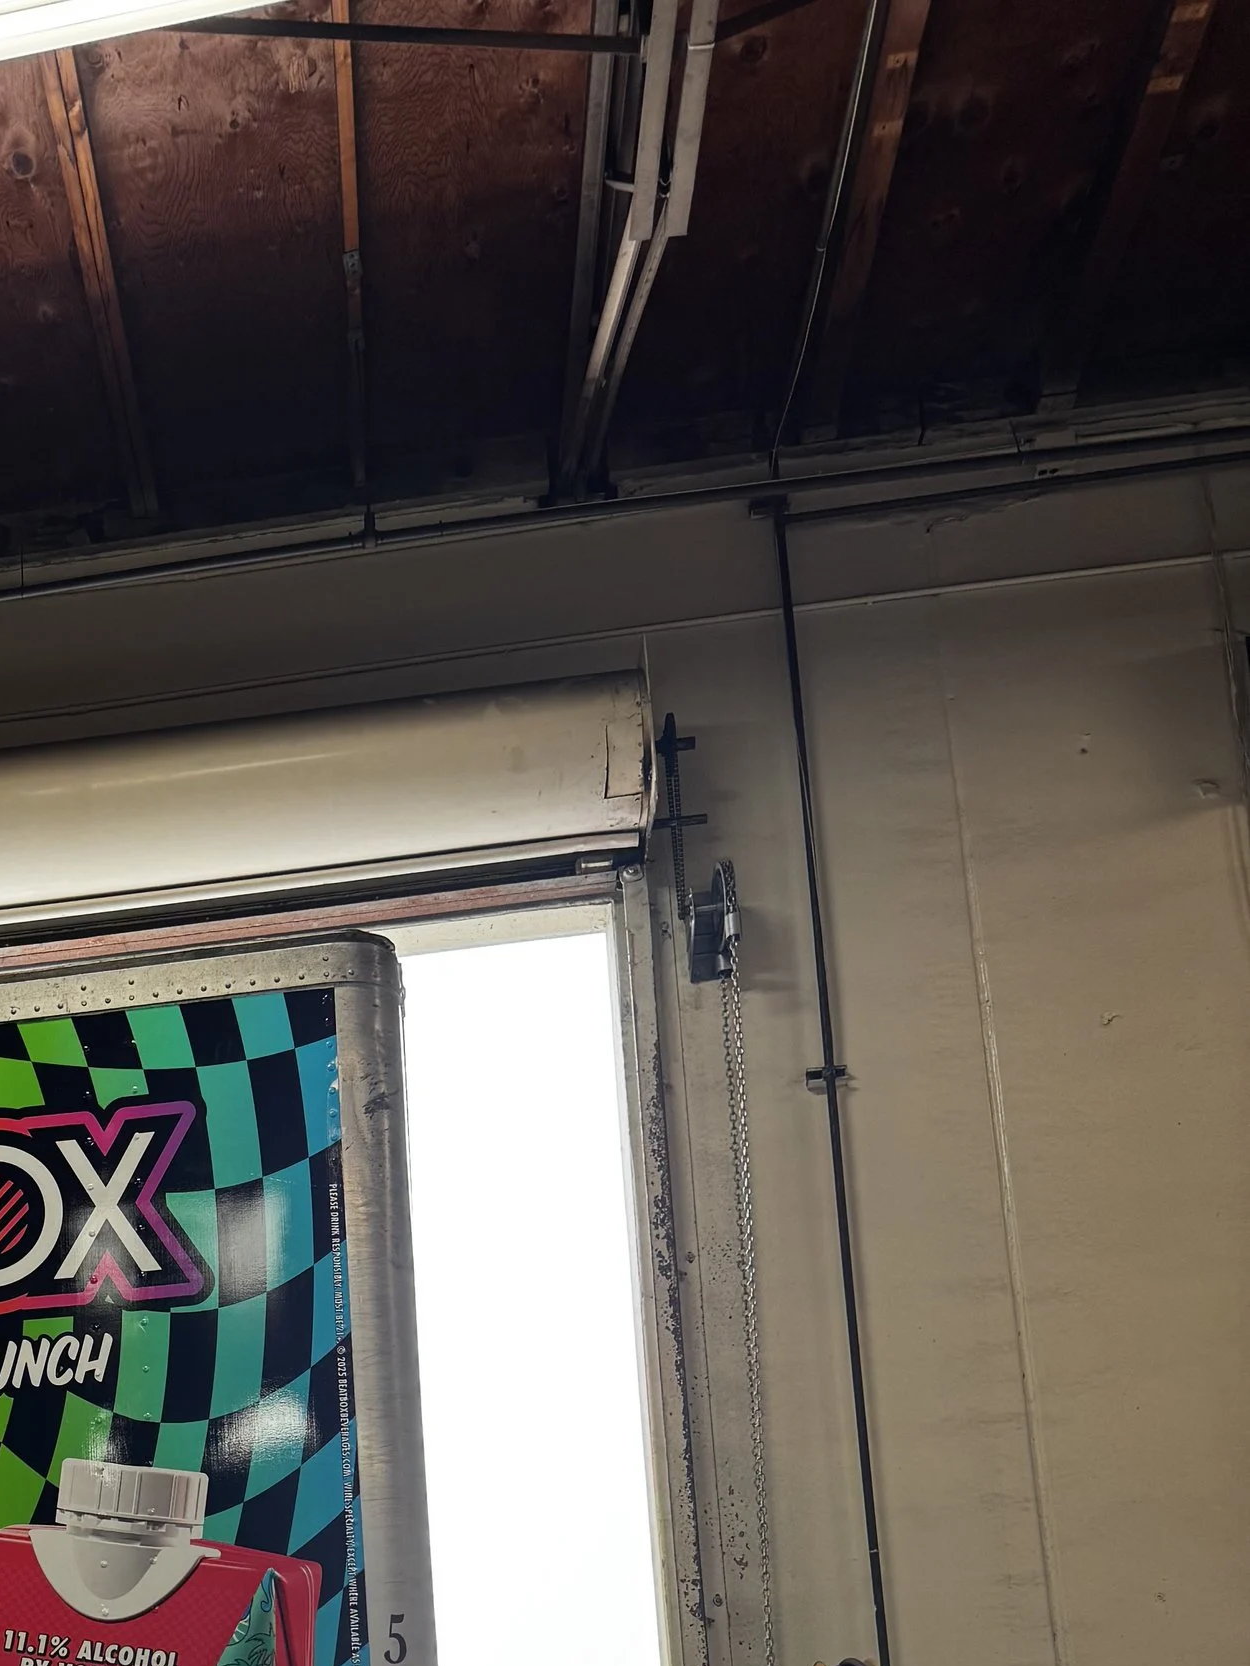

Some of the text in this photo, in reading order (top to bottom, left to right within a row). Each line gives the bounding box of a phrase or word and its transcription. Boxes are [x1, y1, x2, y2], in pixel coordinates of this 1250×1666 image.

[329, 1183, 339, 1210] PLEASE
[330, 1211, 340, 1236] DRINK
[331, 1238, 343, 1289] RESPONSIBLY.
[334, 1291, 344, 1313] MUST
[337, 1356, 347, 1377] 2025
[346, 1547, 358, 1576] EXCEPT
[349, 1577, 359, 1606] WHERE
[4, 1629, 69, 1658] 11.1%
[350, 1608, 360, 1651] AVAILABLE
[351, 1652, 361, 1664] AS
